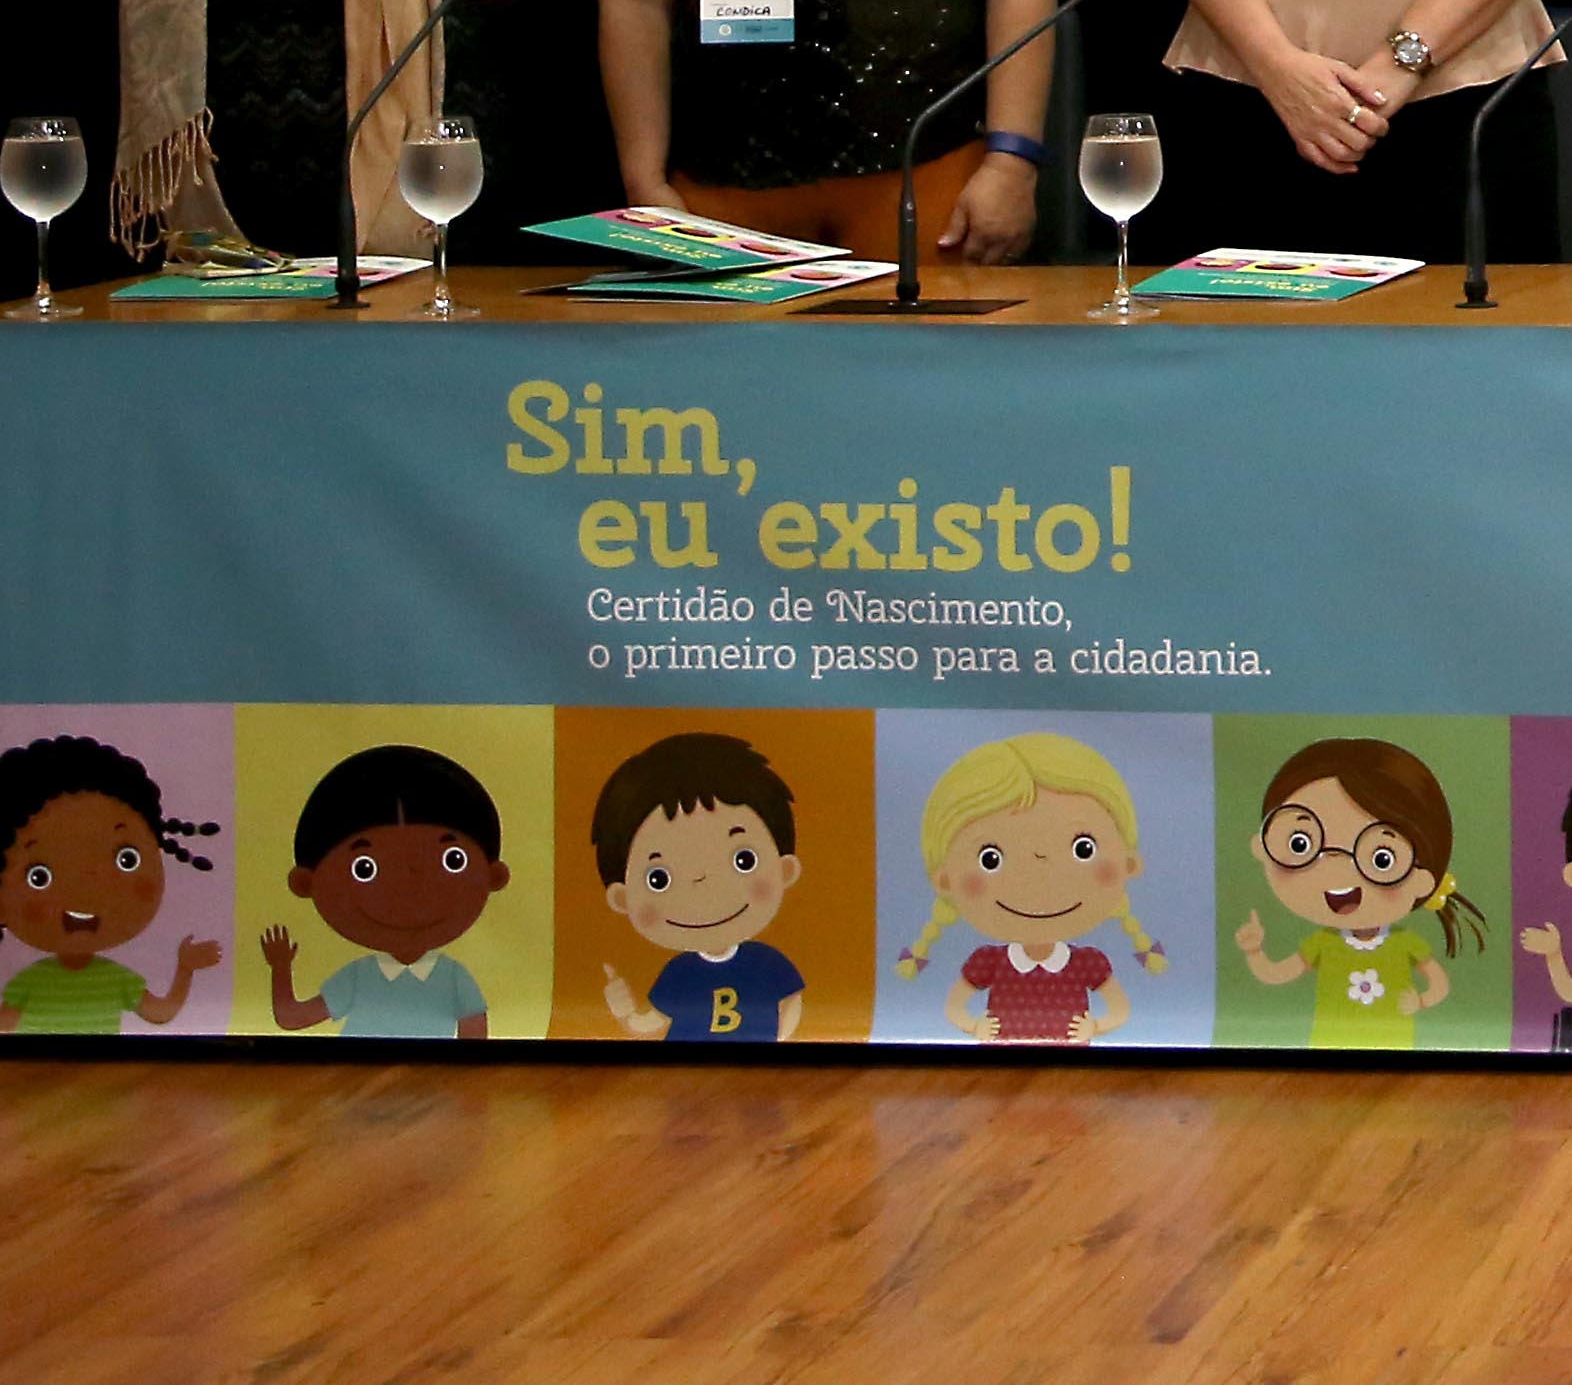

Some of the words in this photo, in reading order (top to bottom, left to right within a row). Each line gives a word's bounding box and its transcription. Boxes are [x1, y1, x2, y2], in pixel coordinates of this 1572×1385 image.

[507, 381, 756, 495] Sim,
[579, 500, 719, 568] eu
[759, 467, 1132, 573] existo!
[586, 587, 755, 625] Certidão
[769, 586, 814, 624] de
[826, 588, 1073, 634] Nascimento,
[588, 644, 611, 669] o
[623, 635, 797, 679] primeiro
[809, 644, 919, 682] passo
[931, 646, 1021, 682] para
[1033, 648, 1057, 675] a
[1069, 636, 1272, 679] cidadania.
[709, 986, 743, 1034] B
